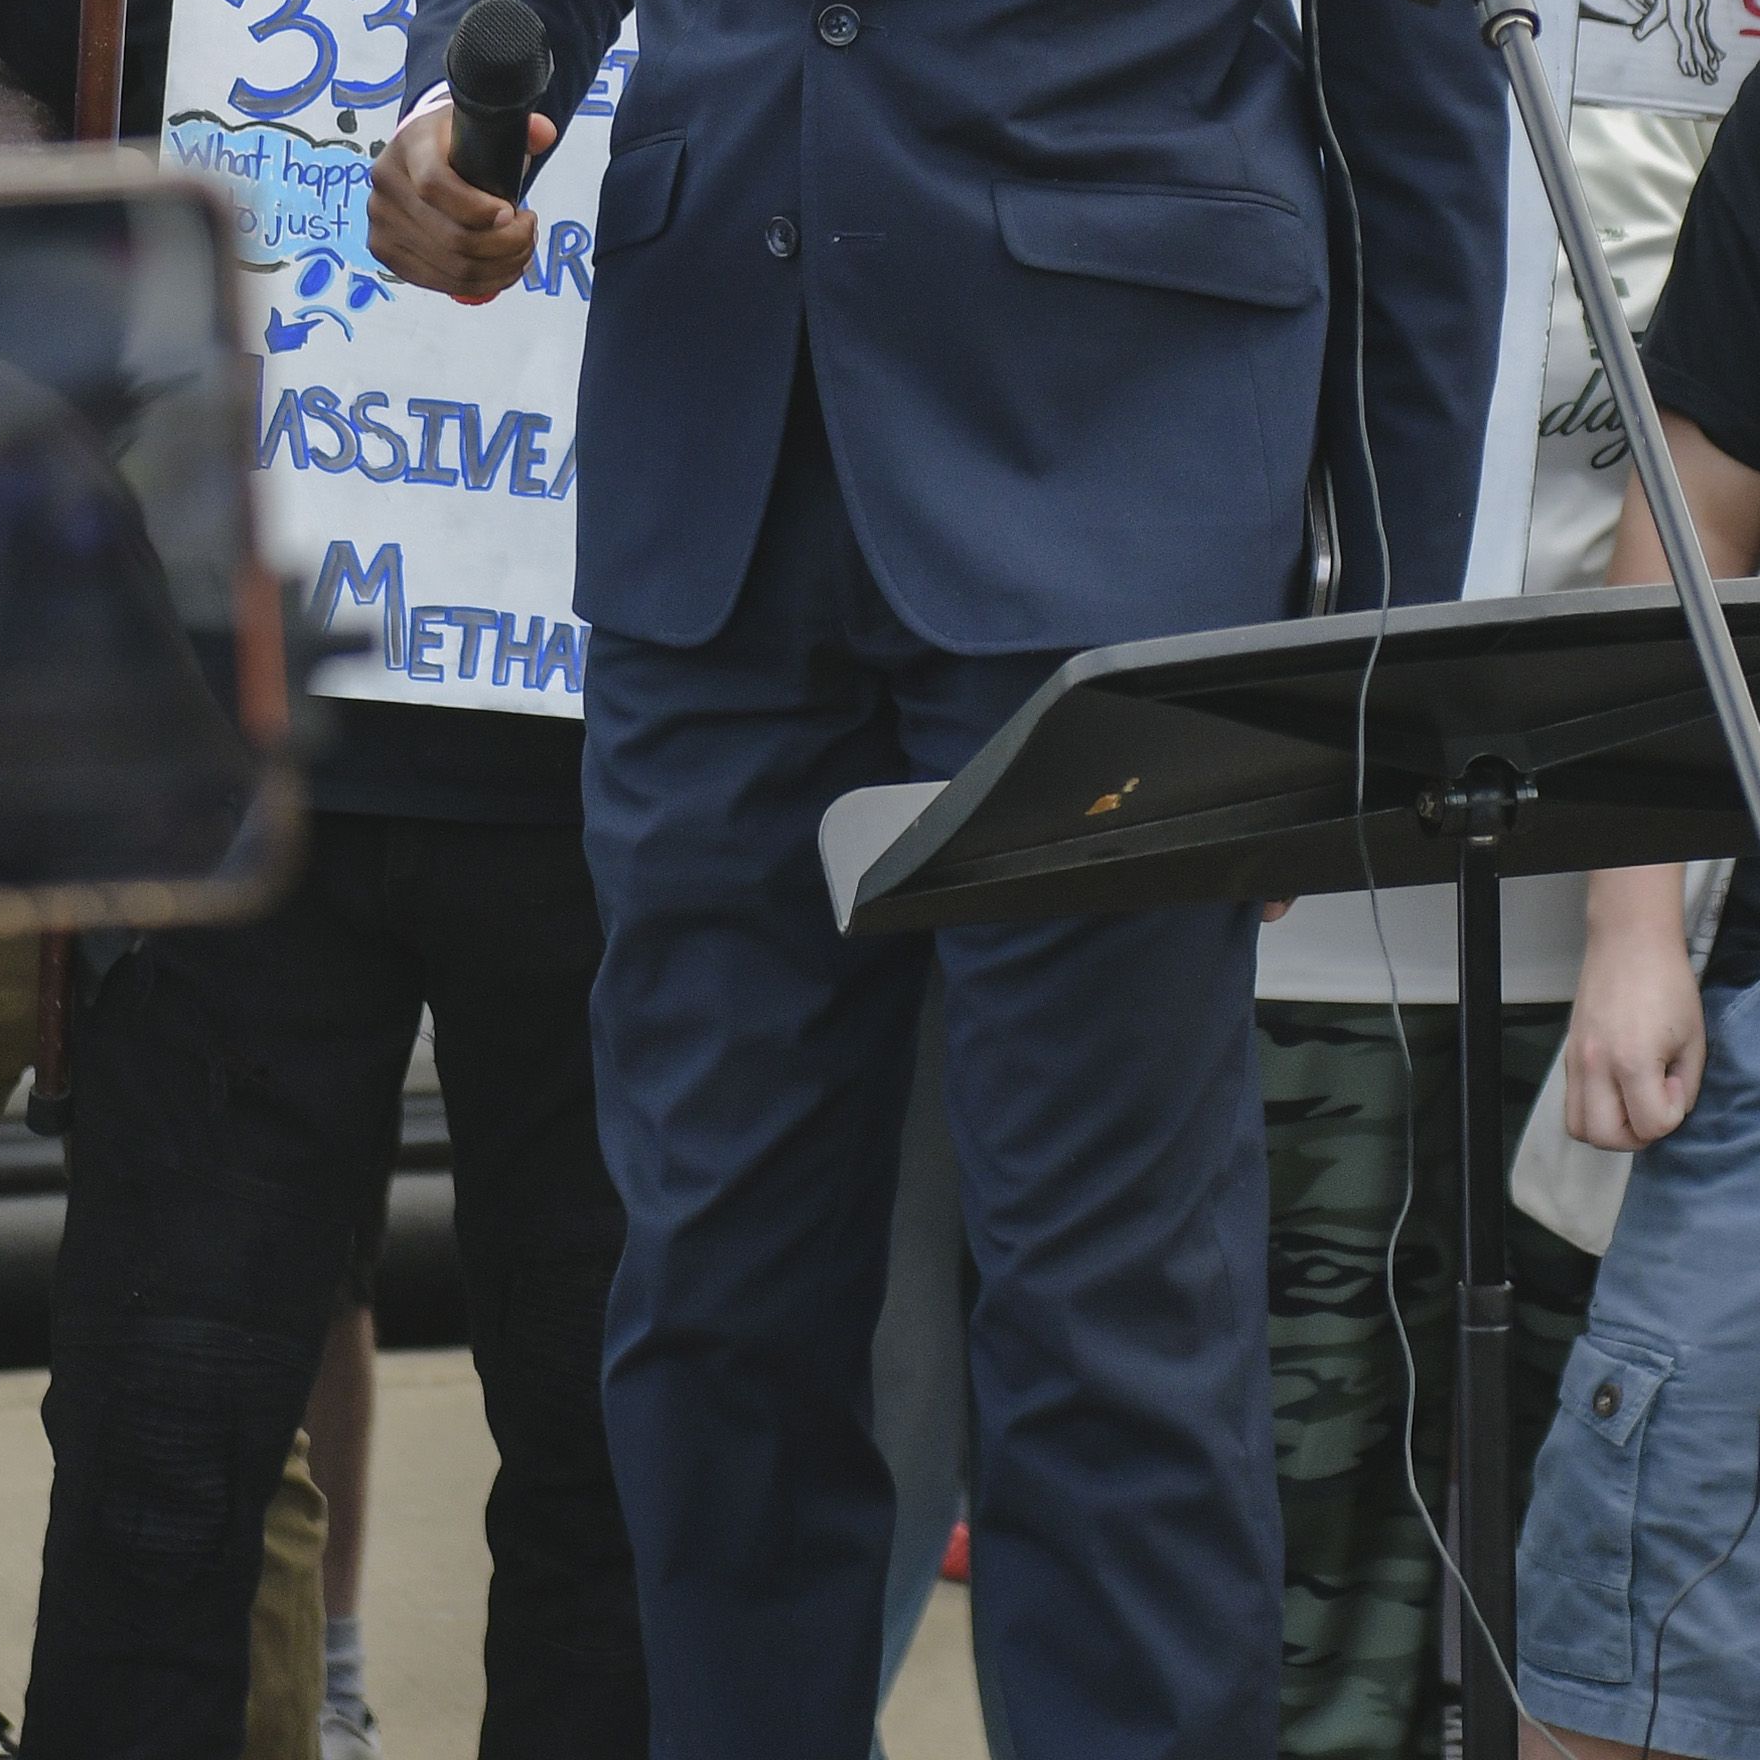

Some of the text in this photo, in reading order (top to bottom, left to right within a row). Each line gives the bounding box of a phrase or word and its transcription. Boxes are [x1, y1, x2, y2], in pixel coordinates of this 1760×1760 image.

[171, 132, 270, 180] What
[265, 200, 349, 245] just
[308, 540, 592, 695] METHA
